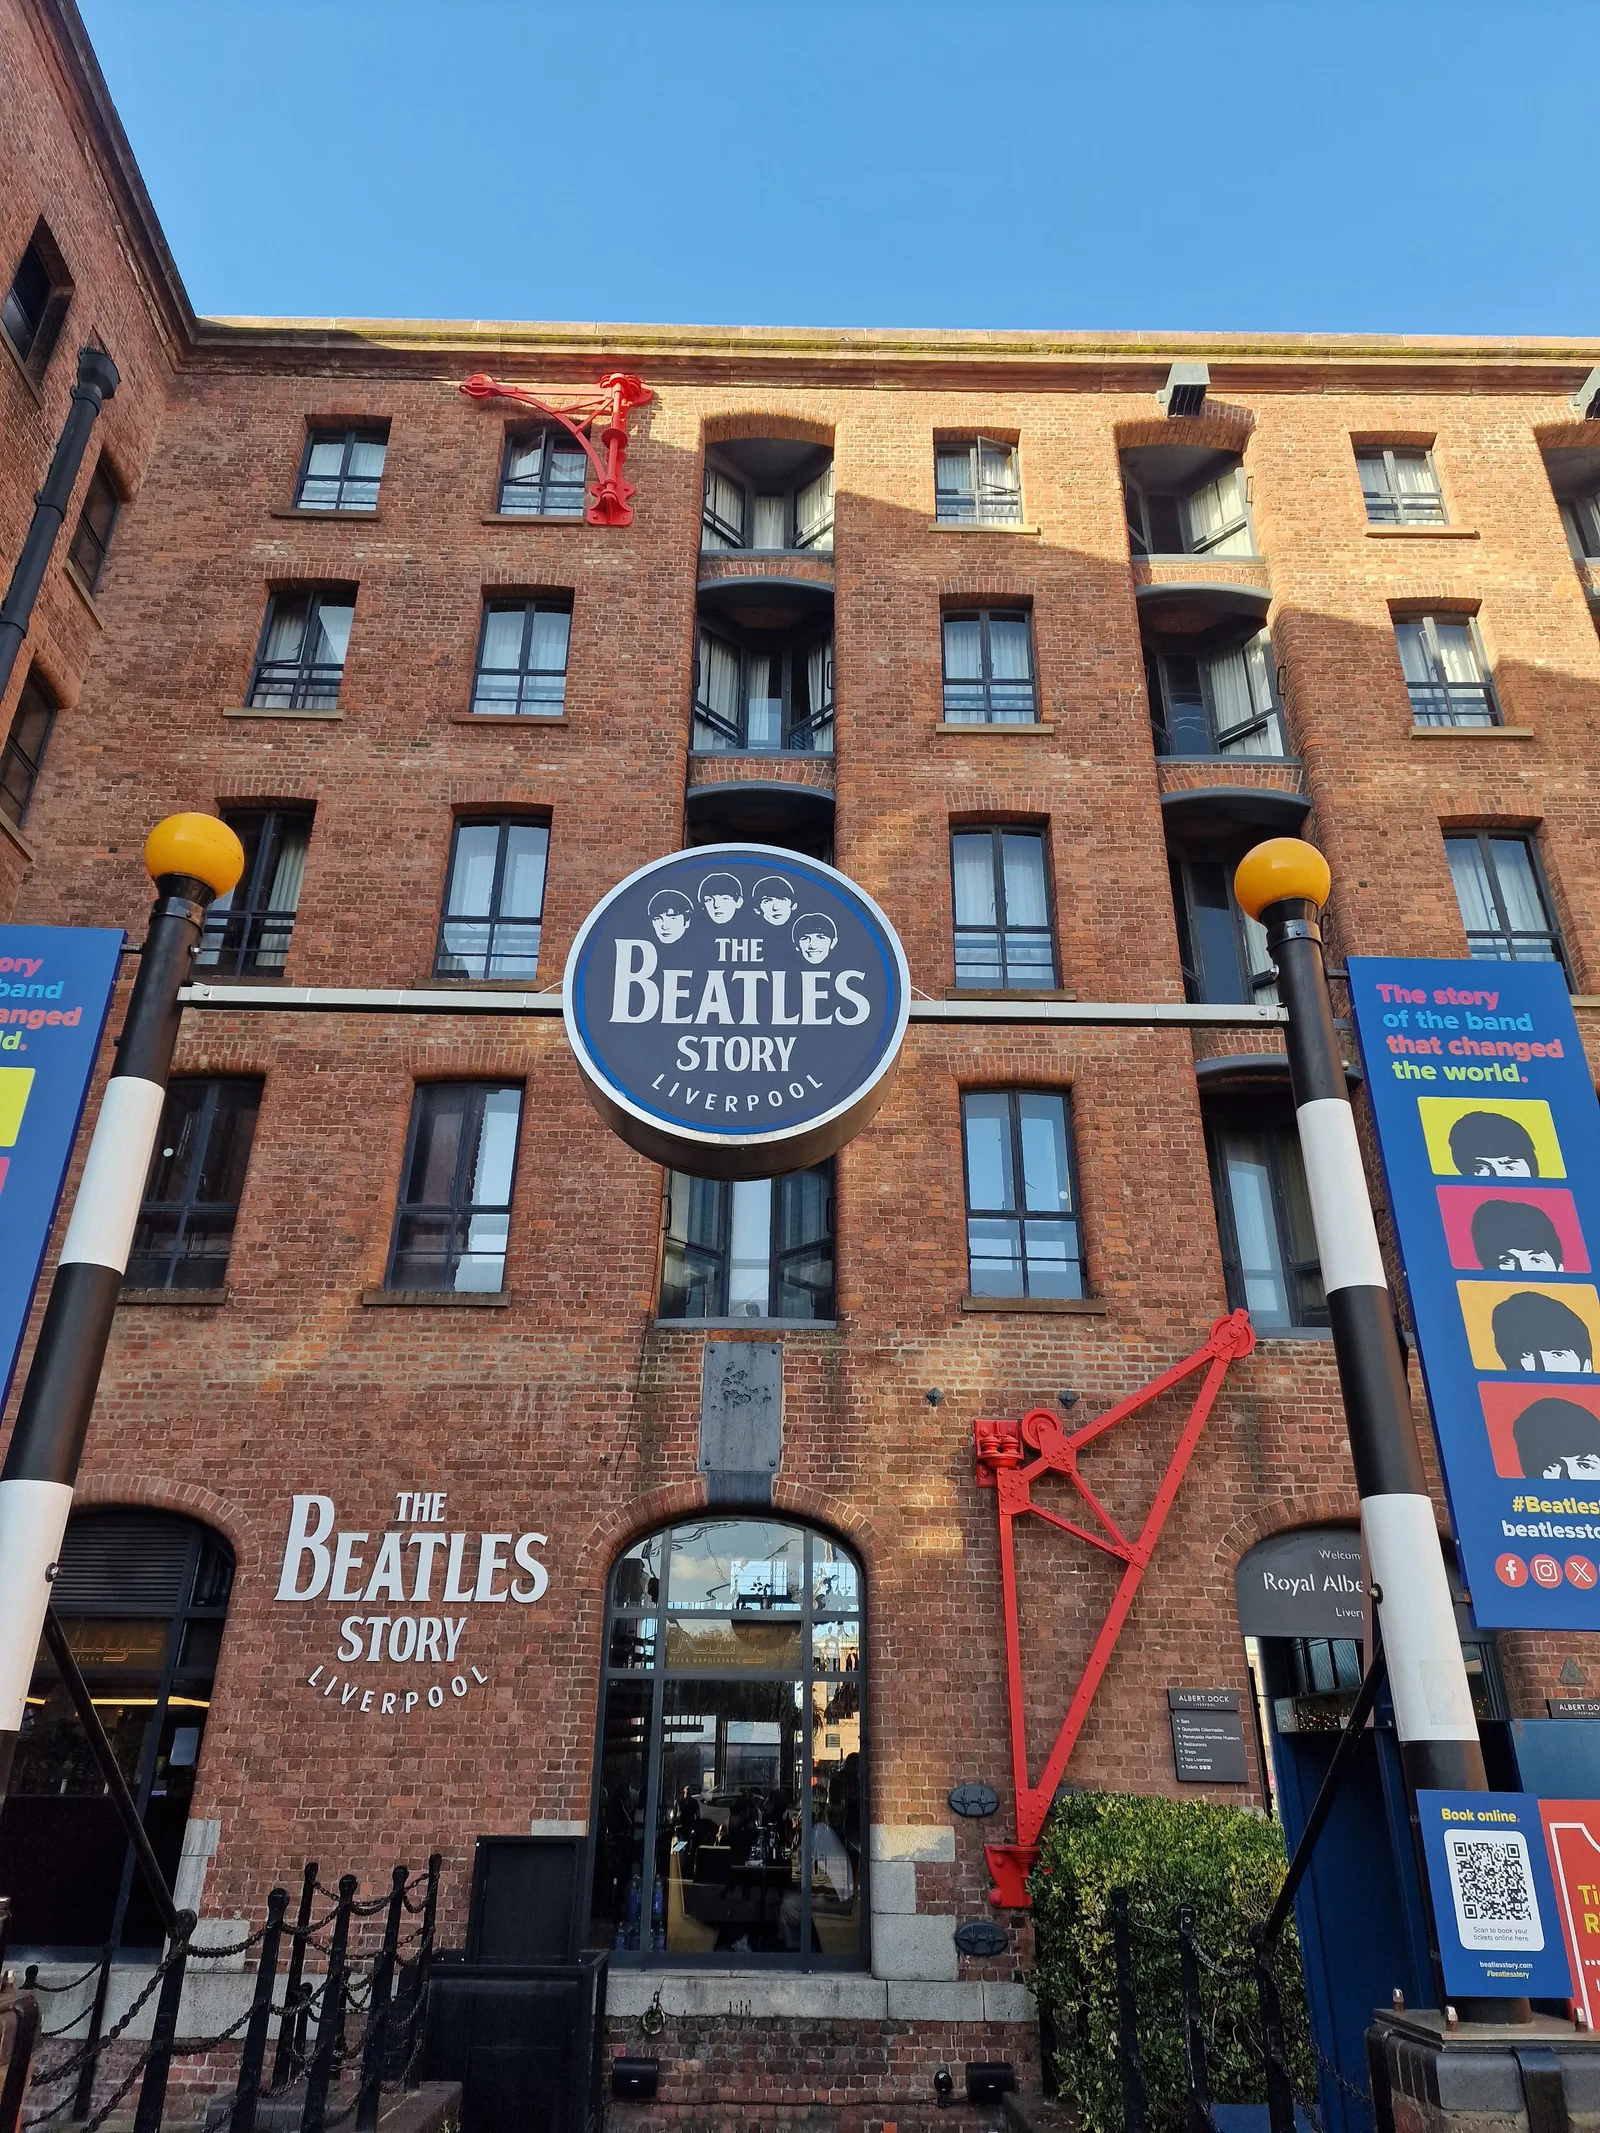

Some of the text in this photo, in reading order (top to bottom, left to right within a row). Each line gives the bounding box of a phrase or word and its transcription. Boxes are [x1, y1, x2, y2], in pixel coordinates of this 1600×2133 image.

[714, 938, 764, 962] THE
[0, 957, 43, 978] ory
[609, 938, 871, 1026] BEATLES
[1376, 983, 1499, 1011] The story
[0, 1006, 83, 1030] anged
[1383, 1010, 1534, 1032] of the band
[676, 1035, 798, 1072] STORY
[1386, 1034, 1564, 1062] that changed
[1392, 1060, 1529, 1084] the world.
[651, 1073, 823, 1112] LIVERPOOL
[396, 1492, 447, 1522] THE
[273, 1494, 549, 1603] BEATLES
[1318, 1550, 1362, 1560] Welcom
[1263, 1572, 1316, 1597] Royal
[337, 1615, 468, 1662] STORY
[307, 1664, 488, 1715] LIVERPOOL
[1441, 1808, 1521, 1823] Book online.
[1577, 1885, 1600, 1905] Ti
[1473, 1926, 1489, 1934] Scan
[1479, 1960, 1533, 1970] beatlesstory.com
[1487, 1970, 1530, 1979] #beatlesstory
